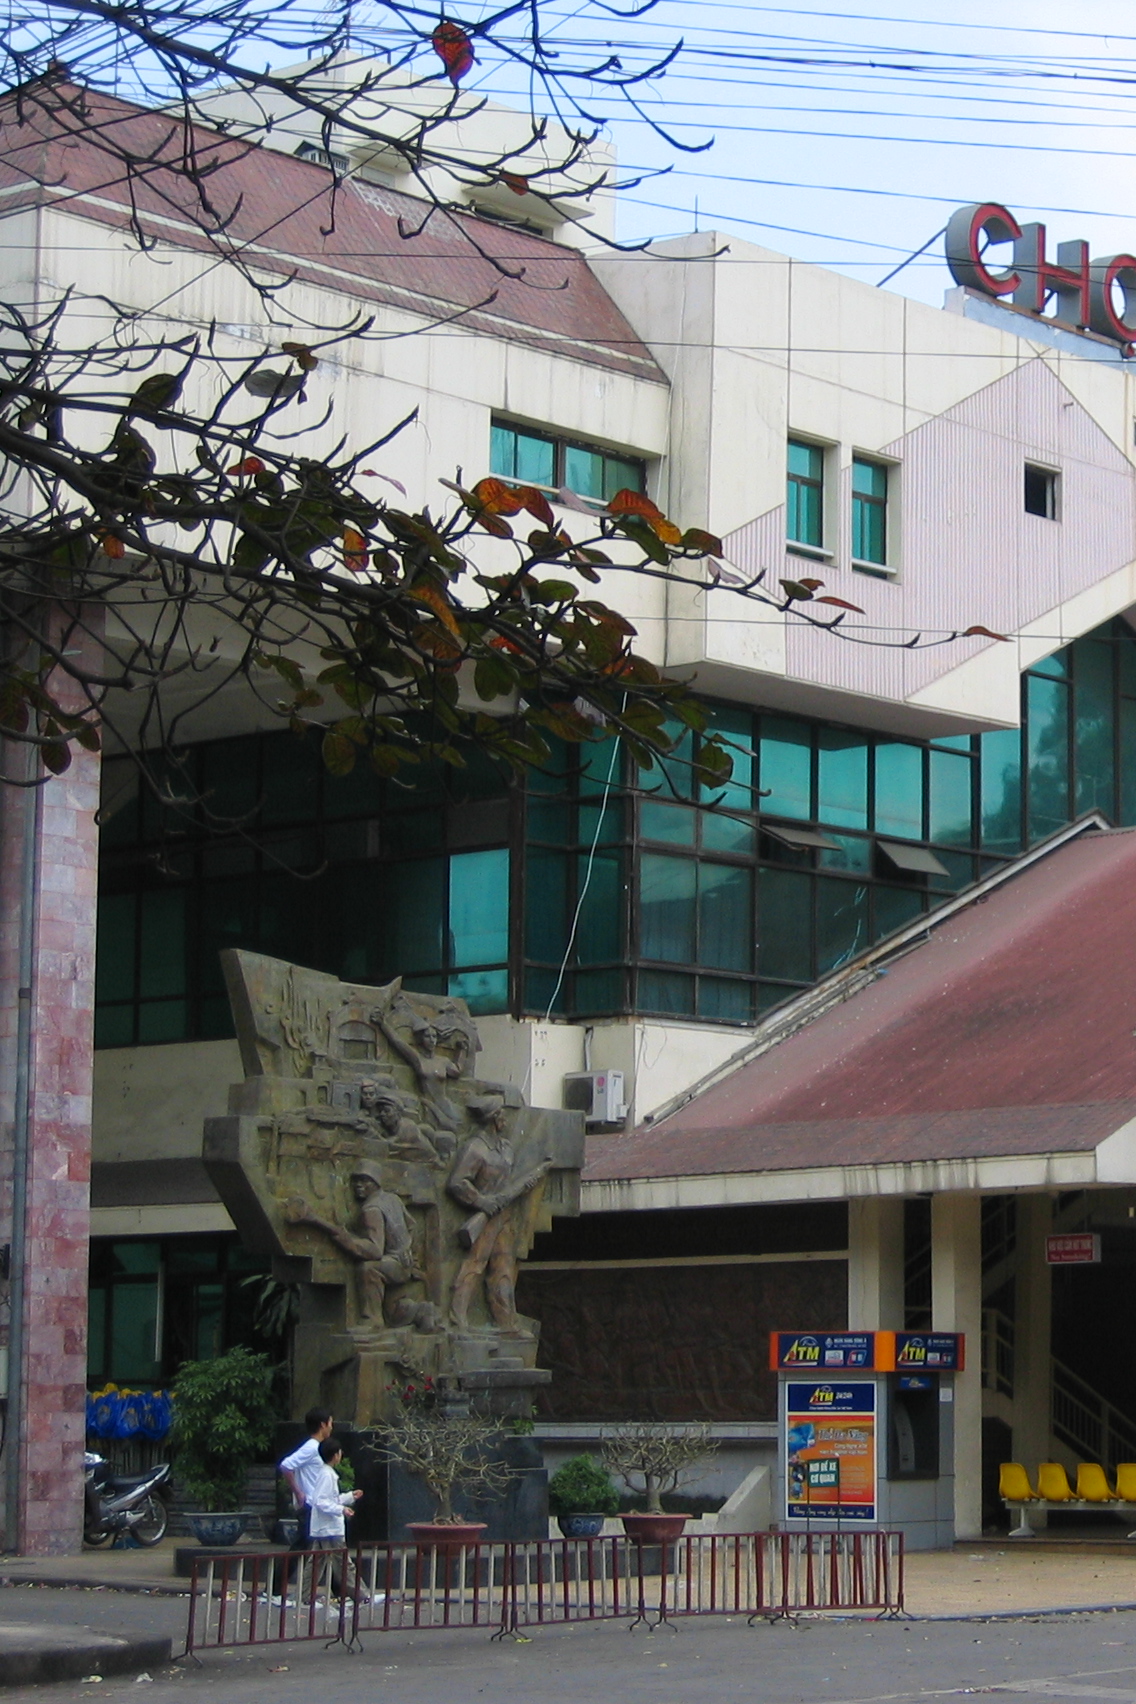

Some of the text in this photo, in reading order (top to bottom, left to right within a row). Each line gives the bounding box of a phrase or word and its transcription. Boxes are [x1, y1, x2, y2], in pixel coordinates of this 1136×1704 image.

[783, 1339, 820, 1362] ATM
[897, 1340, 926, 1361] ATM
[809, 1387, 834, 1403] ATM
